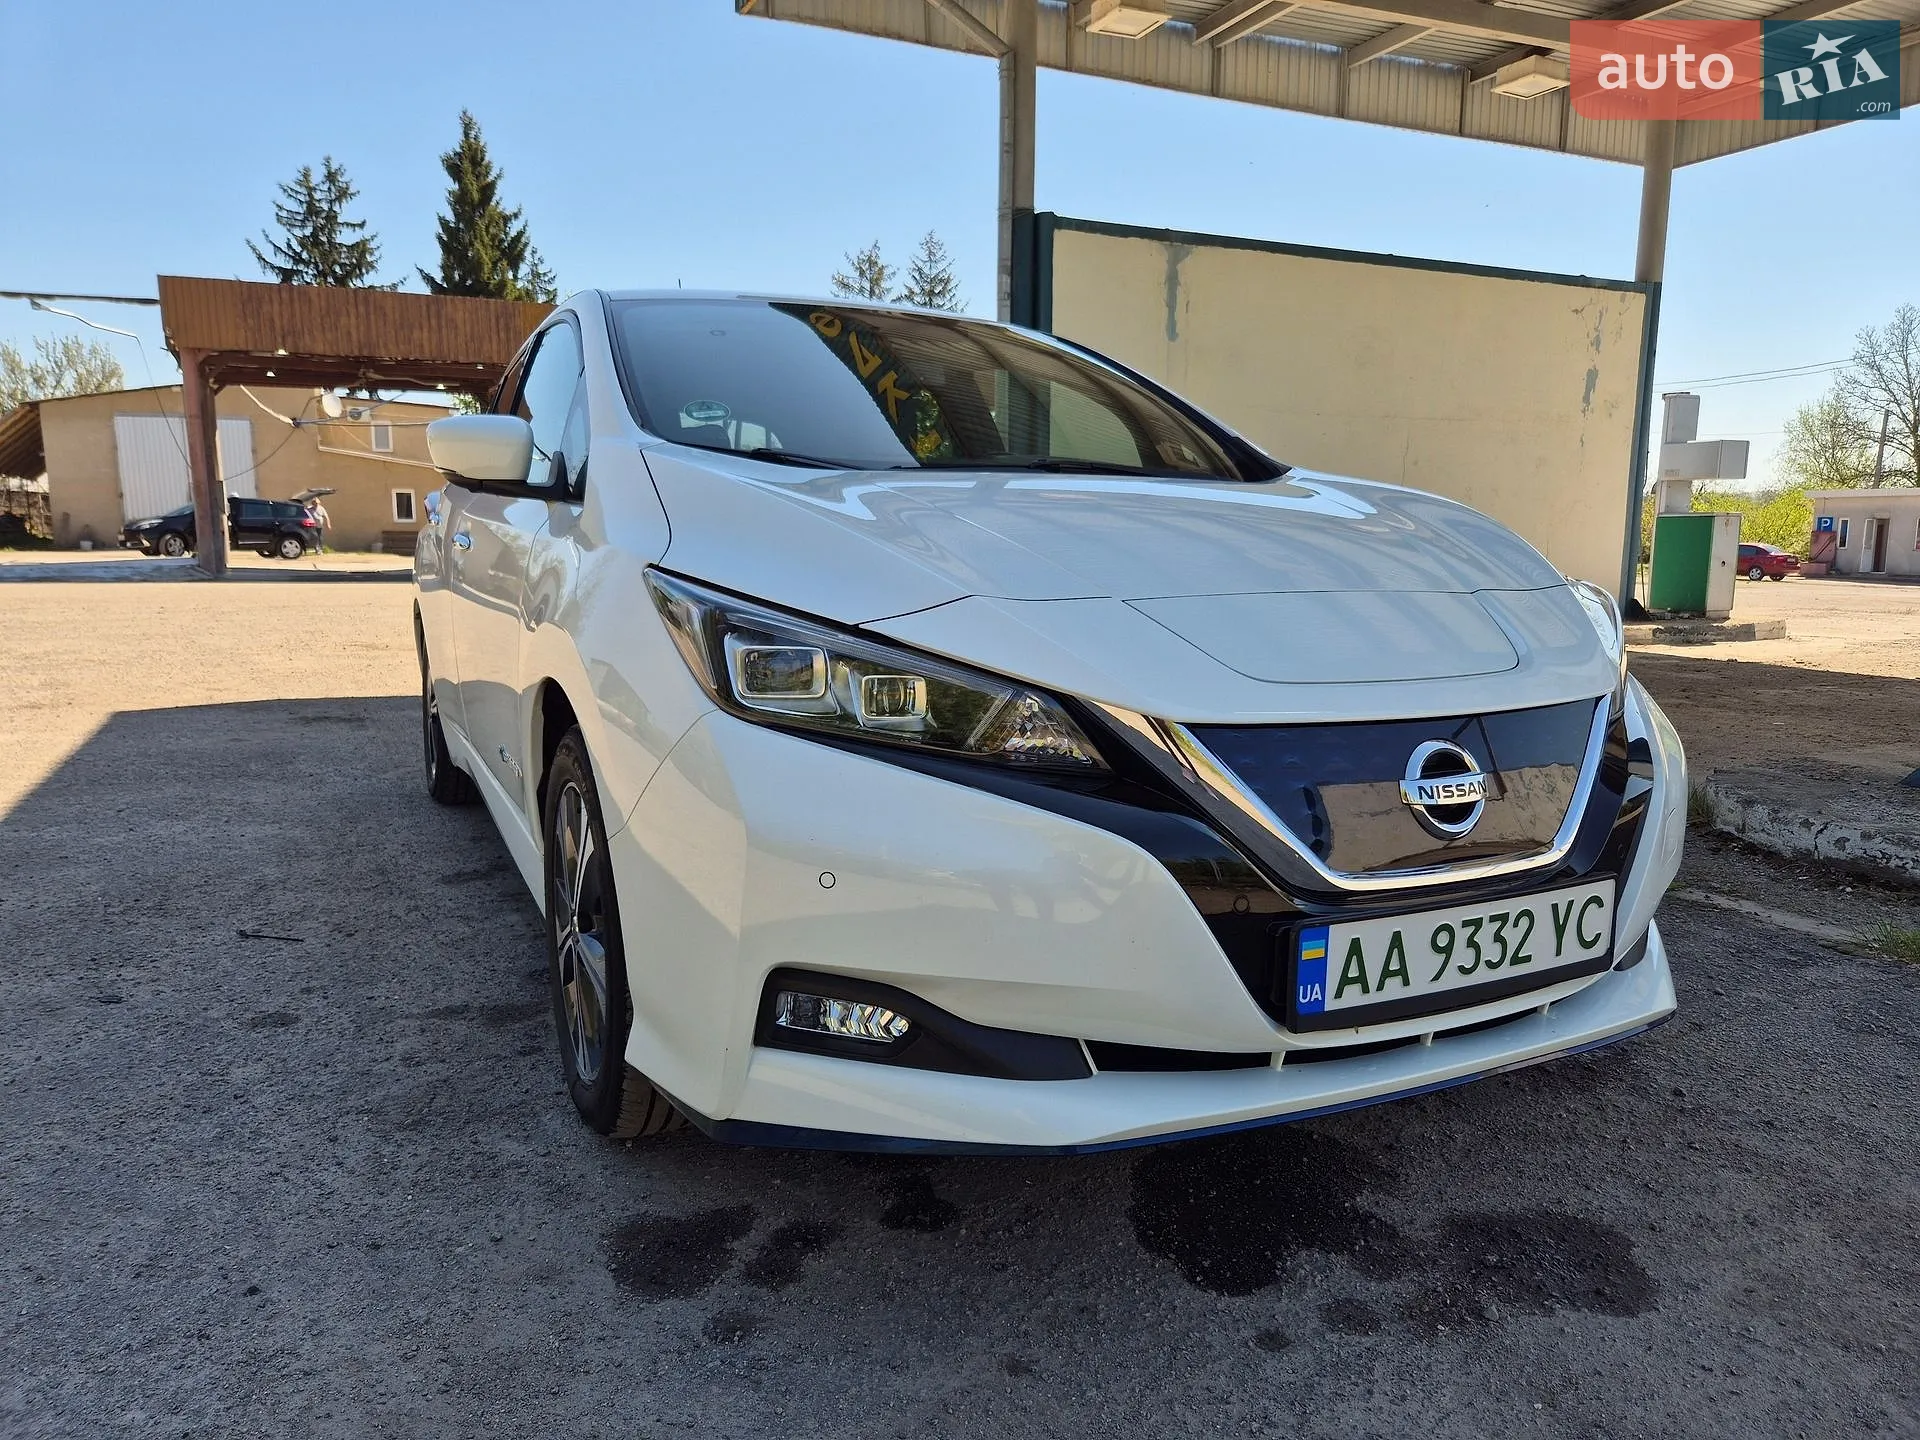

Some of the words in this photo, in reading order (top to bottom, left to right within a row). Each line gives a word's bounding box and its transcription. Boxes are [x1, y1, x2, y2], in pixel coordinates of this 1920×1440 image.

[1821, 518, 1831, 531] P
[1417, 780, 1487, 800] NISSAN
[1334, 930, 1410, 999] AA
[1429, 909, 1535, 982] 9332
[1551, 895, 1604, 957] YC
[1299, 983, 1322, 1003] UA
